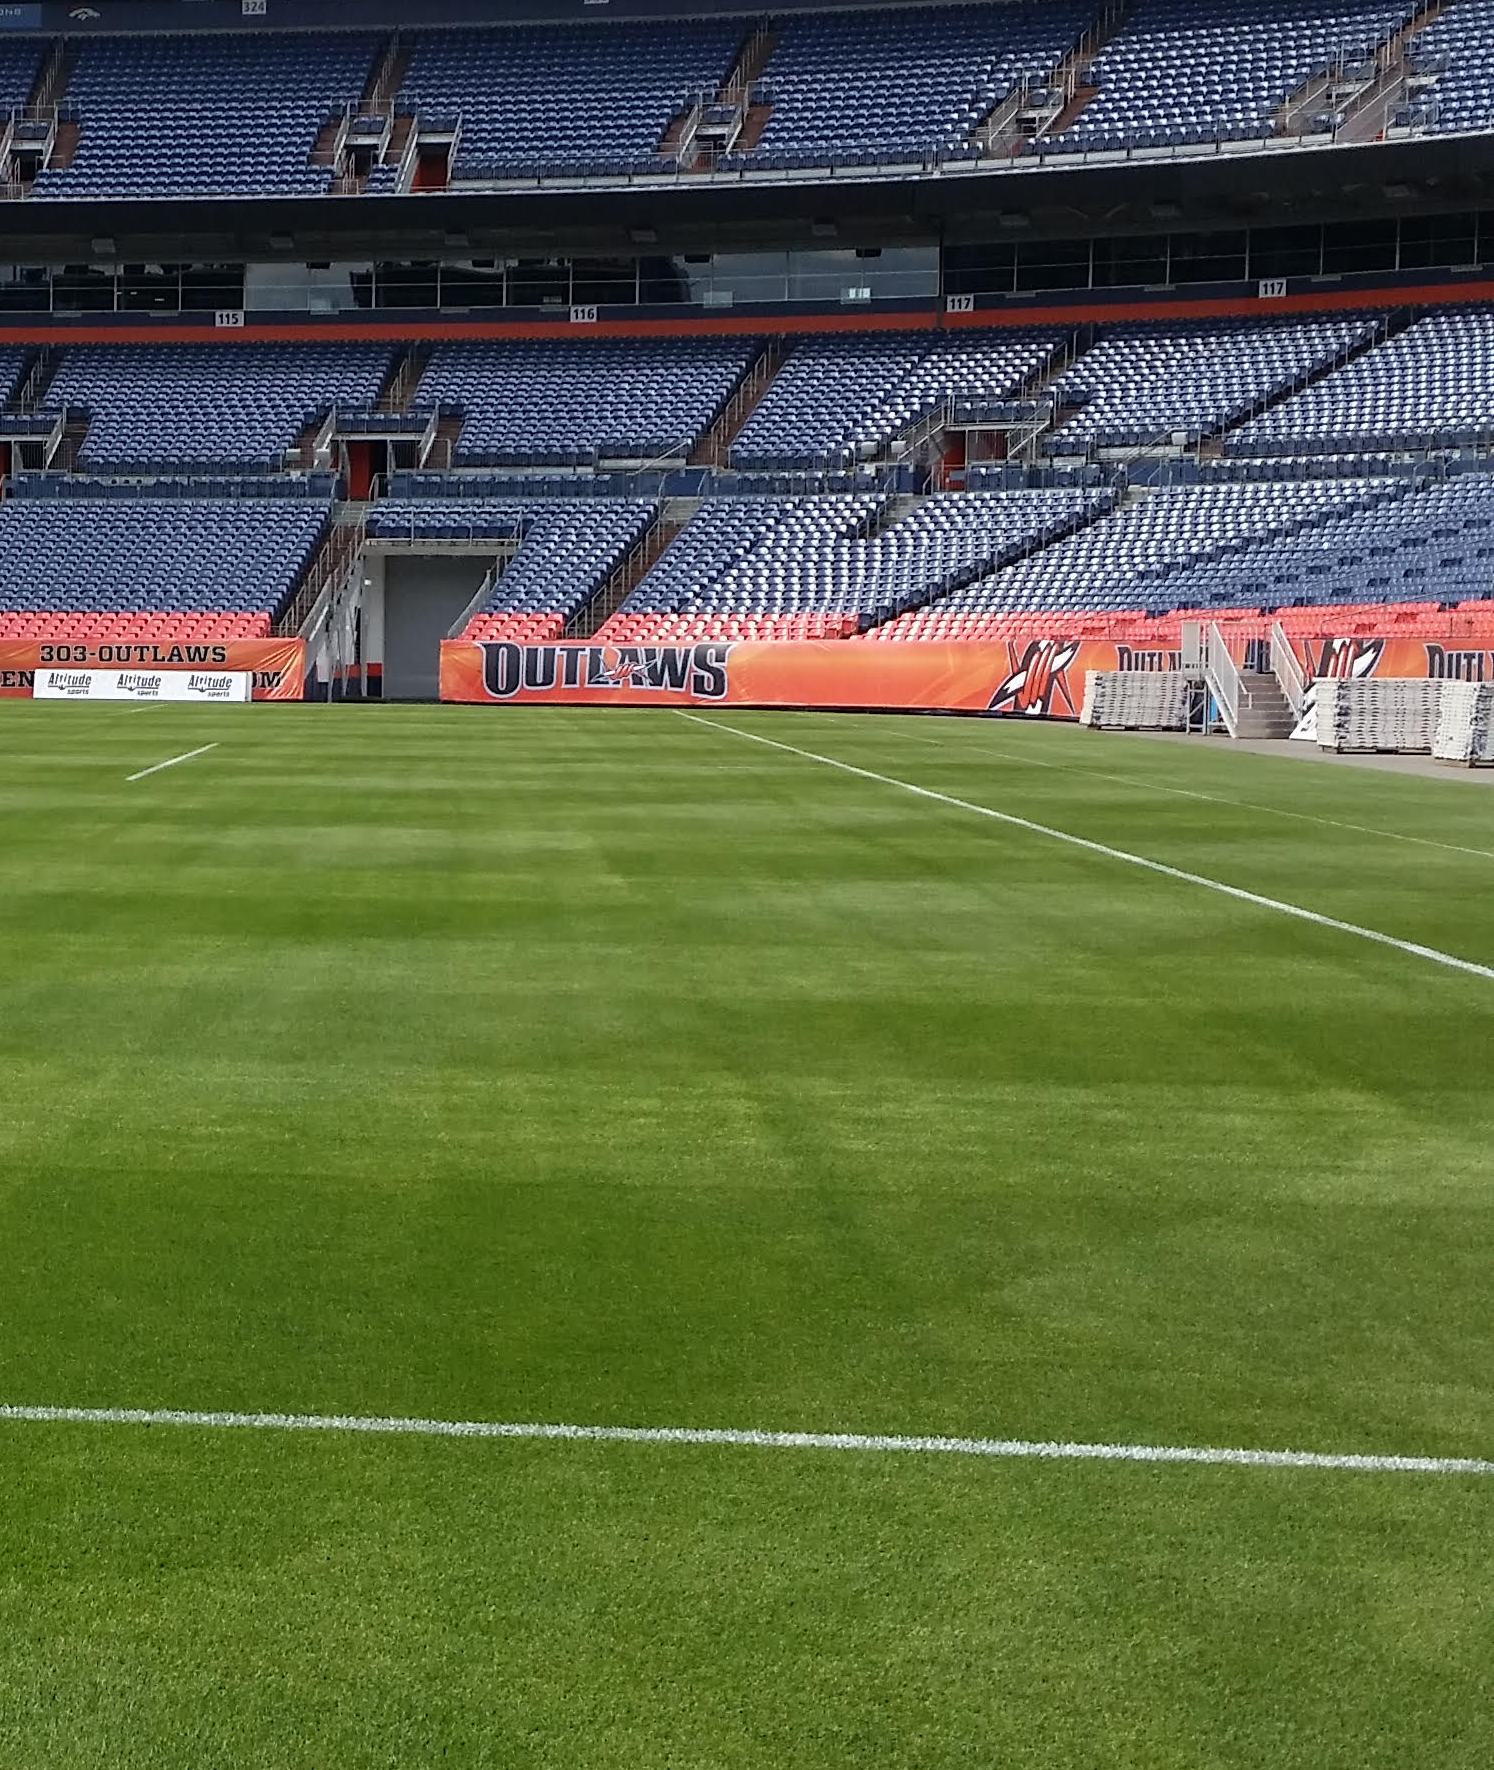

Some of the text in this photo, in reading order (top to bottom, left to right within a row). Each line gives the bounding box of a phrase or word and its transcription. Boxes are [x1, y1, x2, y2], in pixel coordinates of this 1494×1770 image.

[244, 1, 266, 12] 324
[1263, 282, 1284, 295] 117
[950, 297, 971, 310] 117
[219, 313, 239, 325] 115
[574, 308, 595, 320] 116
[39, 644, 228, 663] 303-OUTLAWS
[475, 640, 739, 700] OUTLAWS
[48, 672, 92, 686] Altitude
[117, 673, 161, 687] Altitude
[188, 674, 232, 688] Altitude
